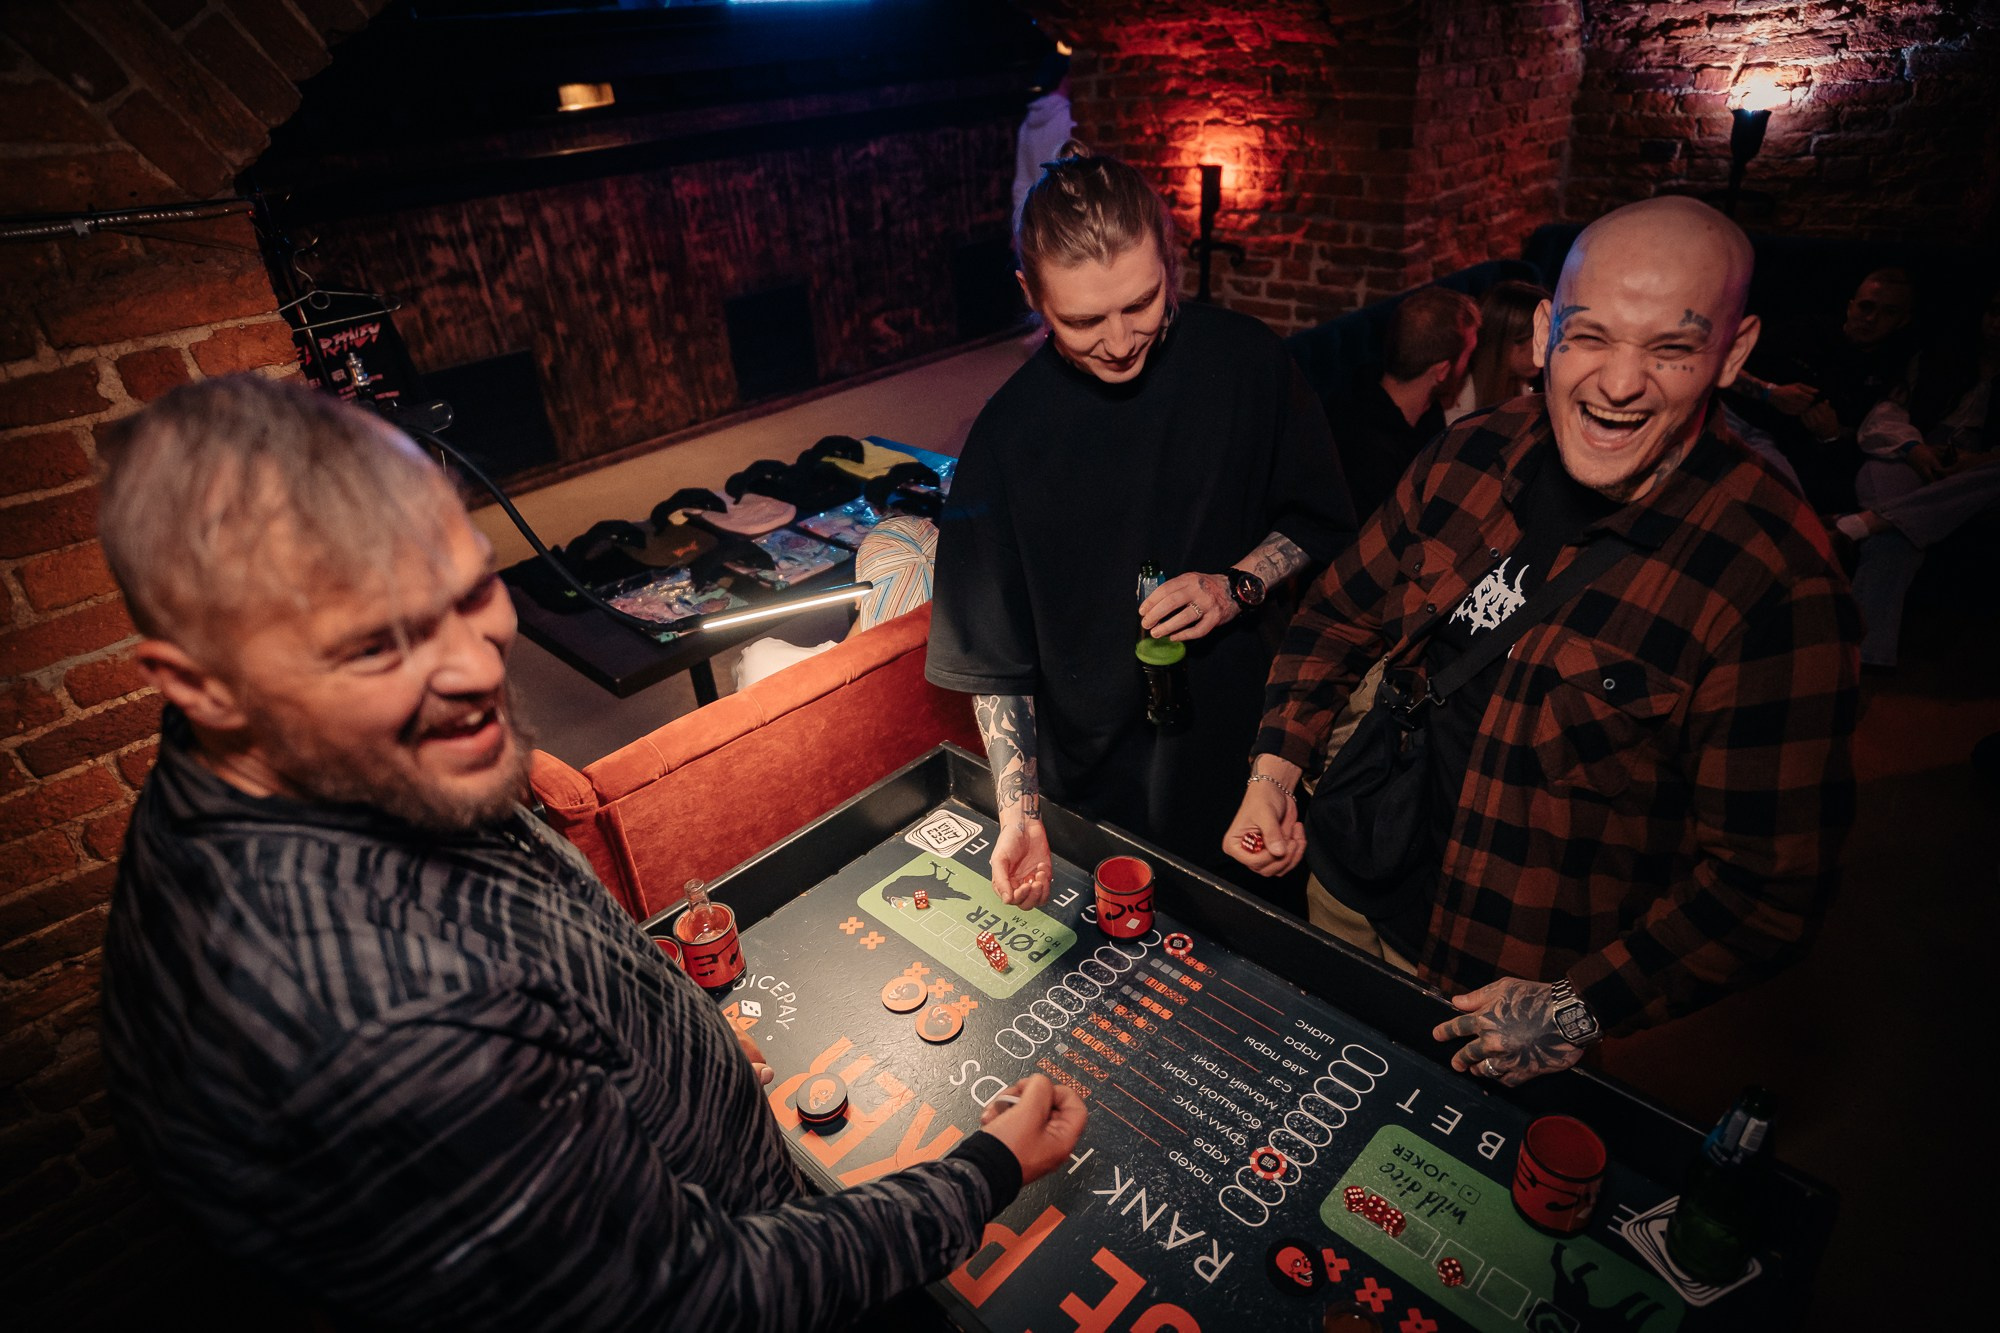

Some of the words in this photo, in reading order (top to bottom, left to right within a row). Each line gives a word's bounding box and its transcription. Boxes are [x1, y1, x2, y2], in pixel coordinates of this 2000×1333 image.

[966, 905, 1051, 963] PØKER
[1032, 929, 1062, 950] HOLD
[1294, 1019, 1334, 1045] шанс
[1243, 1036, 1281, 1061] пары
[1284, 1036, 1322, 1061] пара
[1161, 1061, 1198, 1087] стрит
[1191, 1054, 1229, 1079] стрит
[1281, 1059, 1309, 1076] две
[1228, 1077, 1279, 1111] малый
[1266, 1075, 1292, 1093] сэт
[1171, 1095, 1207, 1120] хаус
[1196, 1085, 1262, 1130] большой
[1207, 1116, 1248, 1146] фулл
[1395, 1088, 1506, 1160] BET
[1193, 1137, 1231, 1166] каре
[1392, 1143, 1449, 1183] JOKER
[1168, 1150, 1214, 1185] покер
[1379, 1162, 1423, 1199] dice
[1415, 1190, 1468, 1226] wild
[1086, 1165, 1235, 1284] RANK
